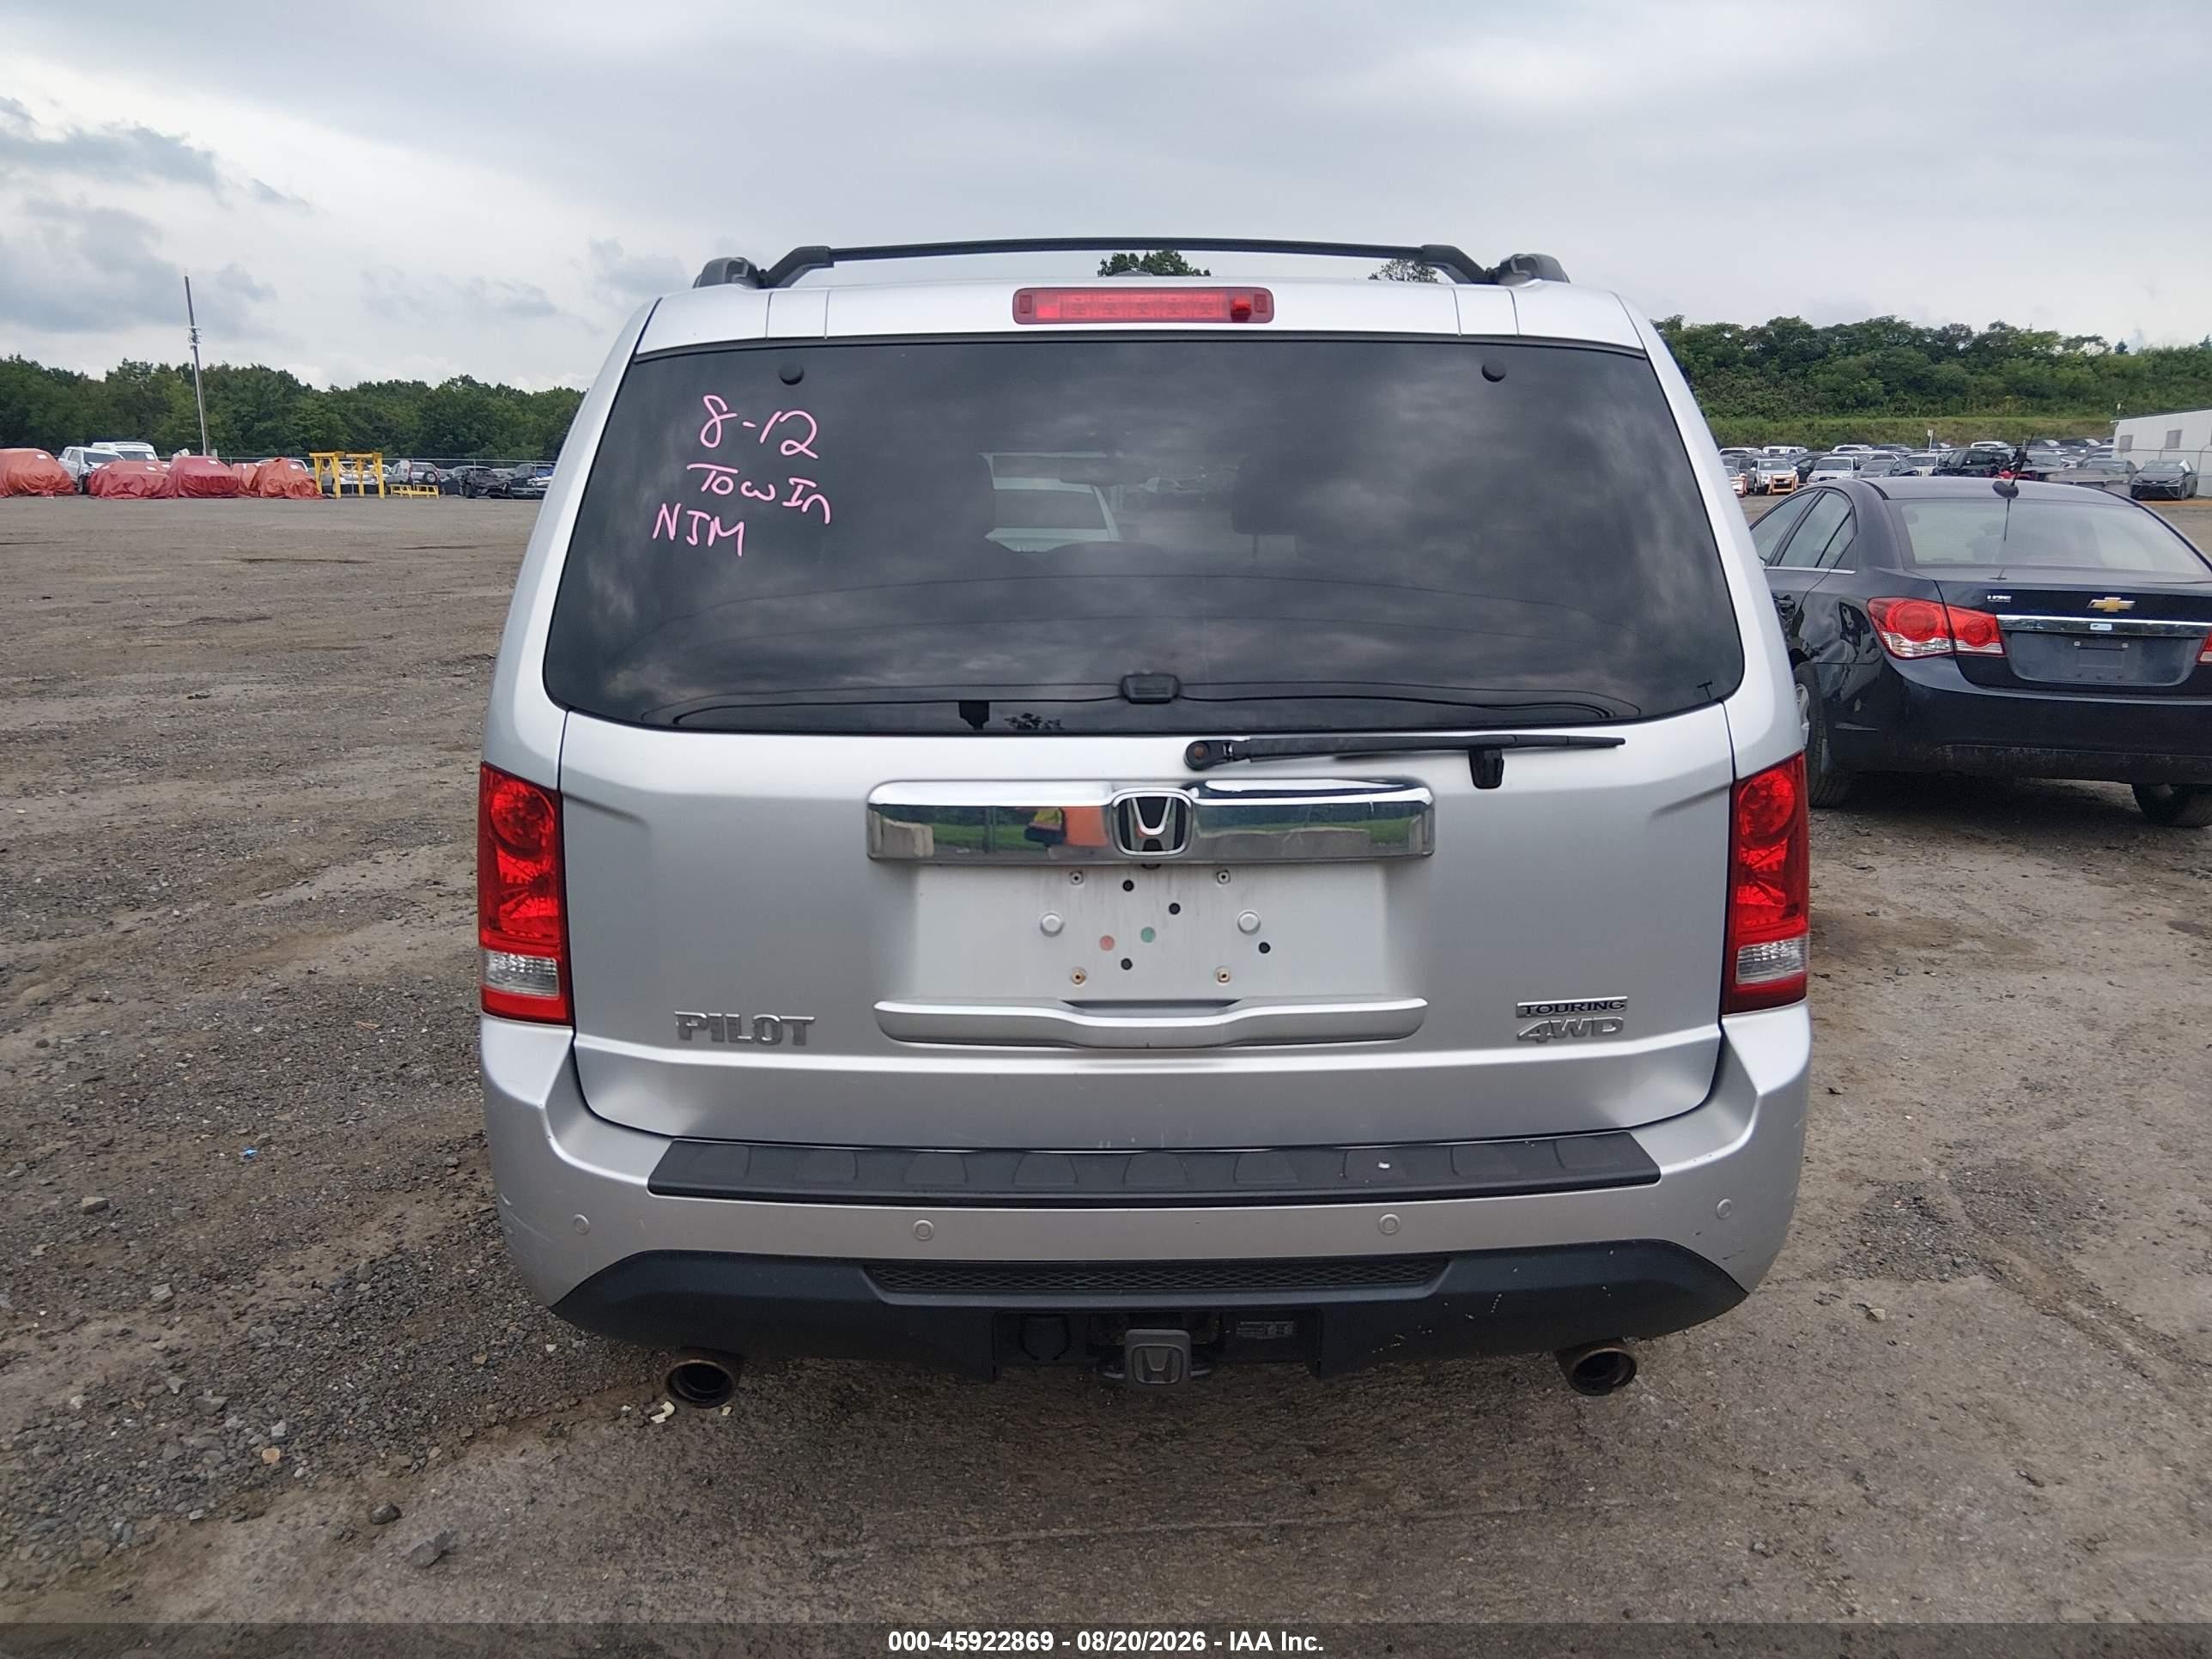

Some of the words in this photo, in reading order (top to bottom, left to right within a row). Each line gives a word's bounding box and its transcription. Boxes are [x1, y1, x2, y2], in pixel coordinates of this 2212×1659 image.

[700, 394, 818, 459] 8-12
[781, 477, 831, 525] In
[1522, 1000, 1626, 1016] TOURING
[674, 1010, 815, 1046] PILOT
[1516, 1016, 1624, 1043] 4WD
